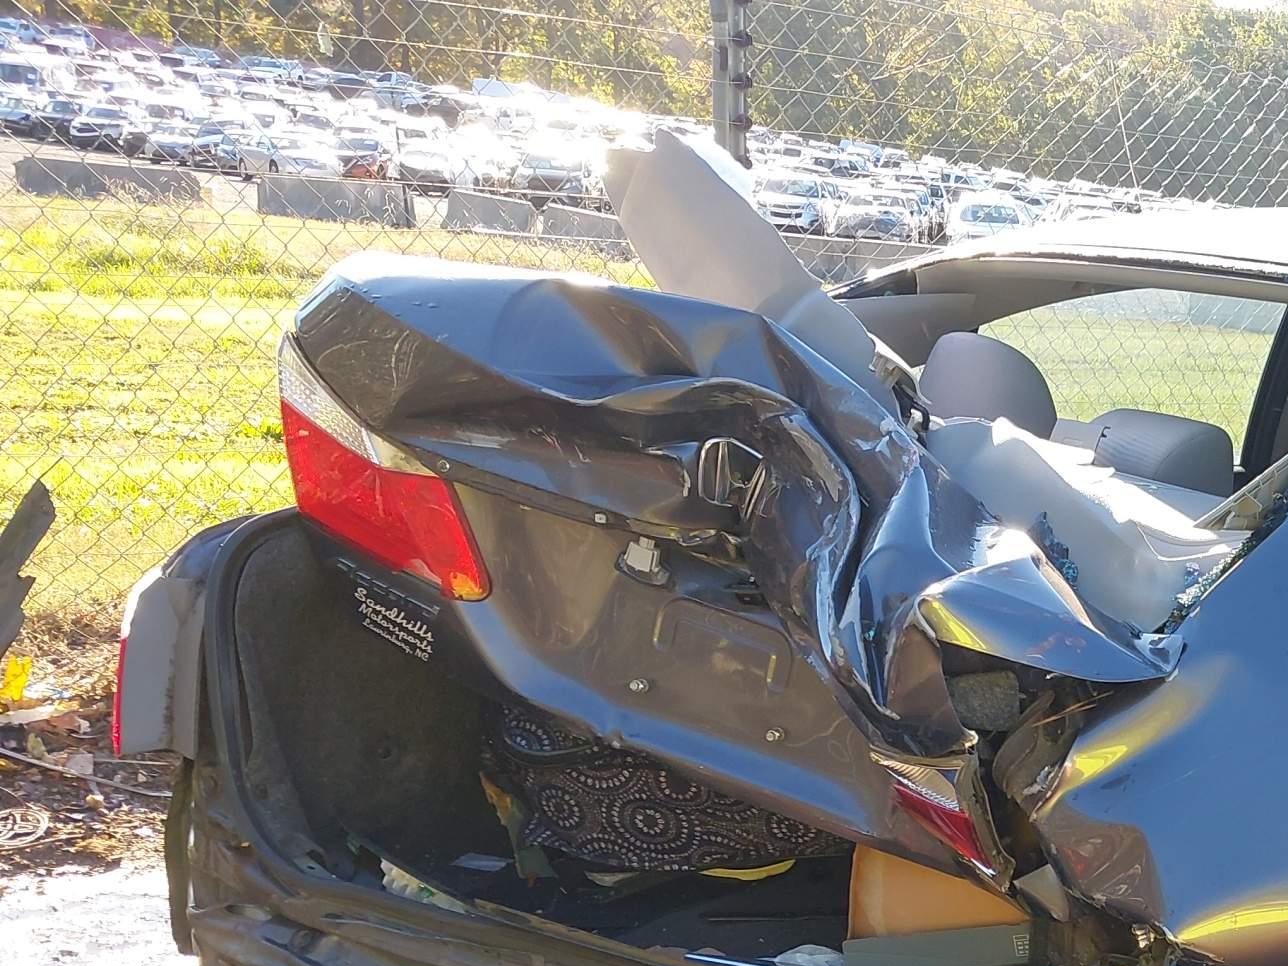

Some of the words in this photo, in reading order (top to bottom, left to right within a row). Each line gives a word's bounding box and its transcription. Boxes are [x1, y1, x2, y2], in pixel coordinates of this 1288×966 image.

[354, 587, 434, 642] Sandhills
[358, 603, 432, 653] Motorsports
[415, 649, 429, 661] NC
